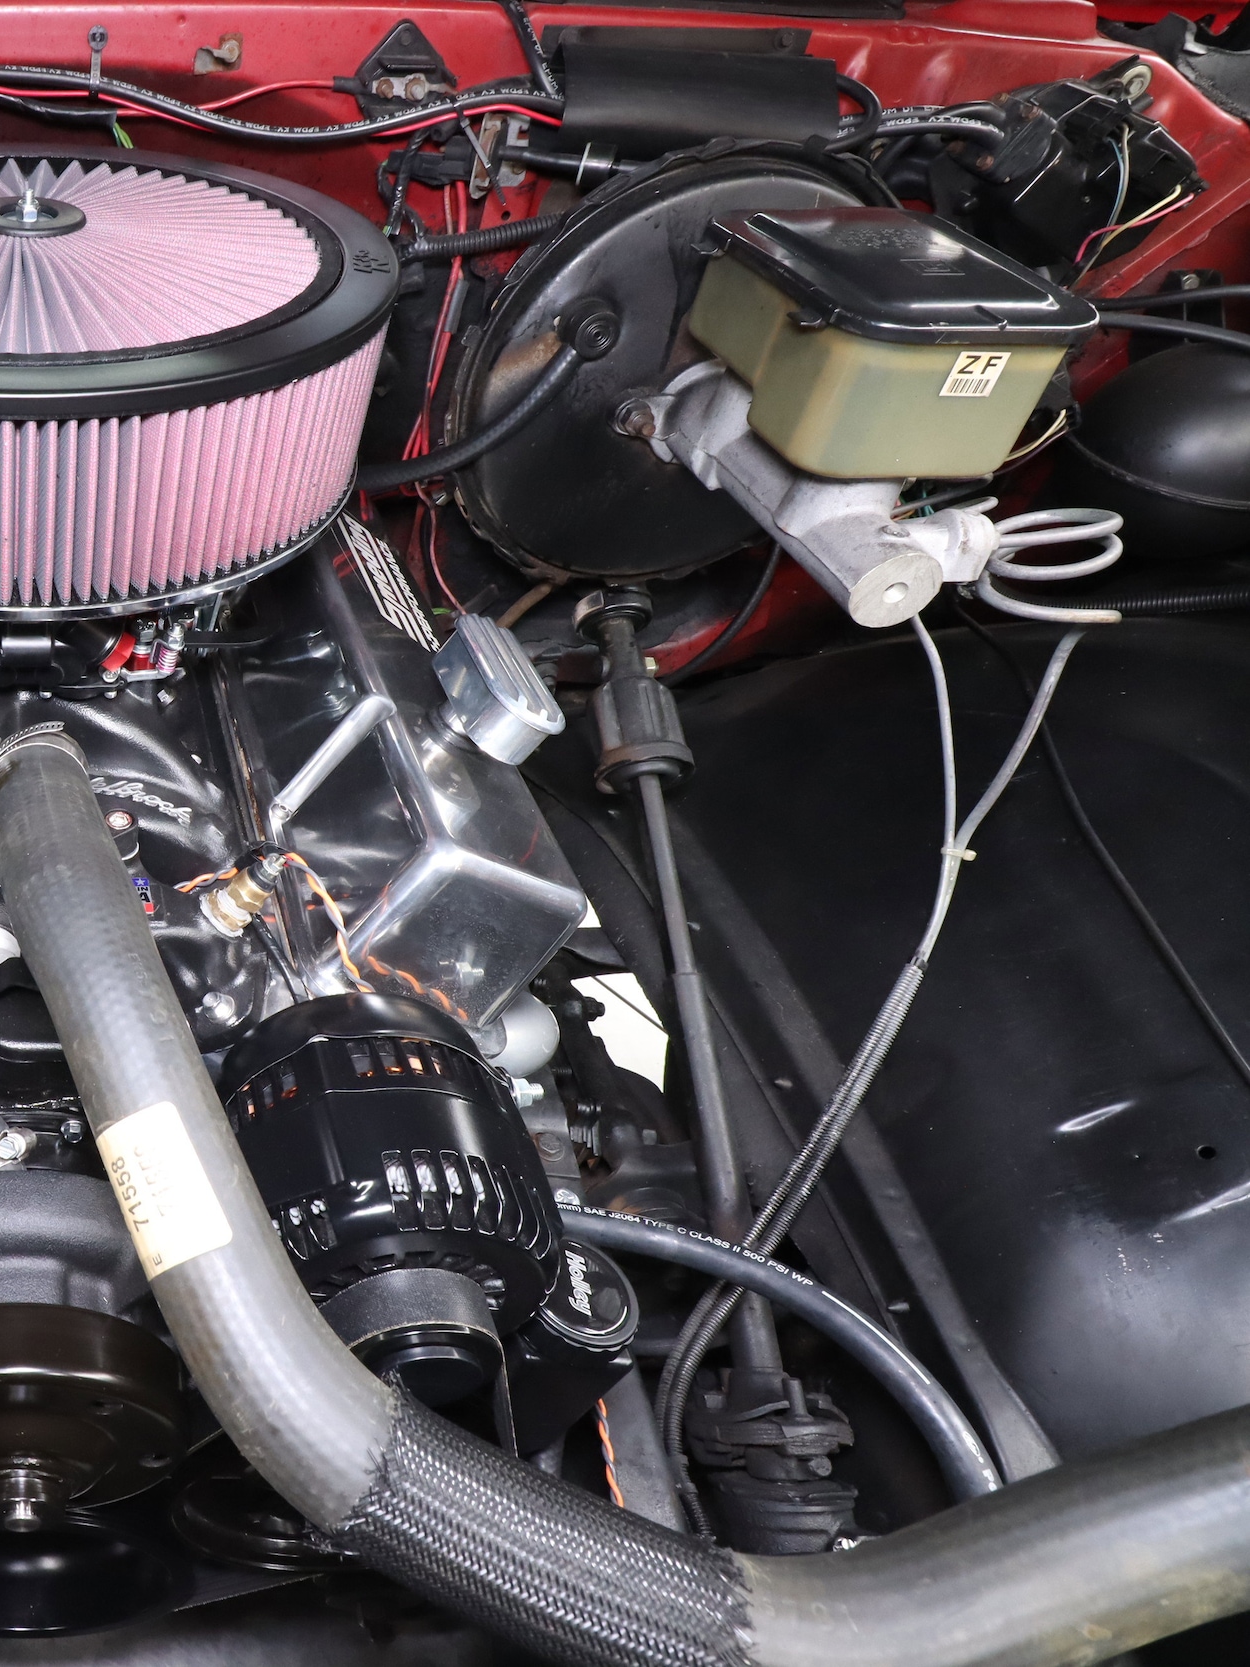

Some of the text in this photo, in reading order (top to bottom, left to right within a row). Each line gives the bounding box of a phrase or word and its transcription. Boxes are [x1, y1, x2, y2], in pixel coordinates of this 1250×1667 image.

[500, 87, 529, 96] EPDM
[394, 105, 423, 118] EPDM
[342, 119, 371, 130] EPDM
[956, 355, 1004, 375] ZF
[111, 1156, 150, 1233] 71558
[583, 1206, 607, 1218] SAE
[607, 1211, 642, 1224] J2064
[642, 1217, 675, 1232] TYPE
[676, 1226, 688, 1235] C
[688, 1230, 731, 1250] CLASS
[741, 1249, 766, 1265] 500
[766, 1259, 790, 1276] PSI
[790, 1271, 815, 1288] WP
[565, 1250, 593, 1317] Holley
